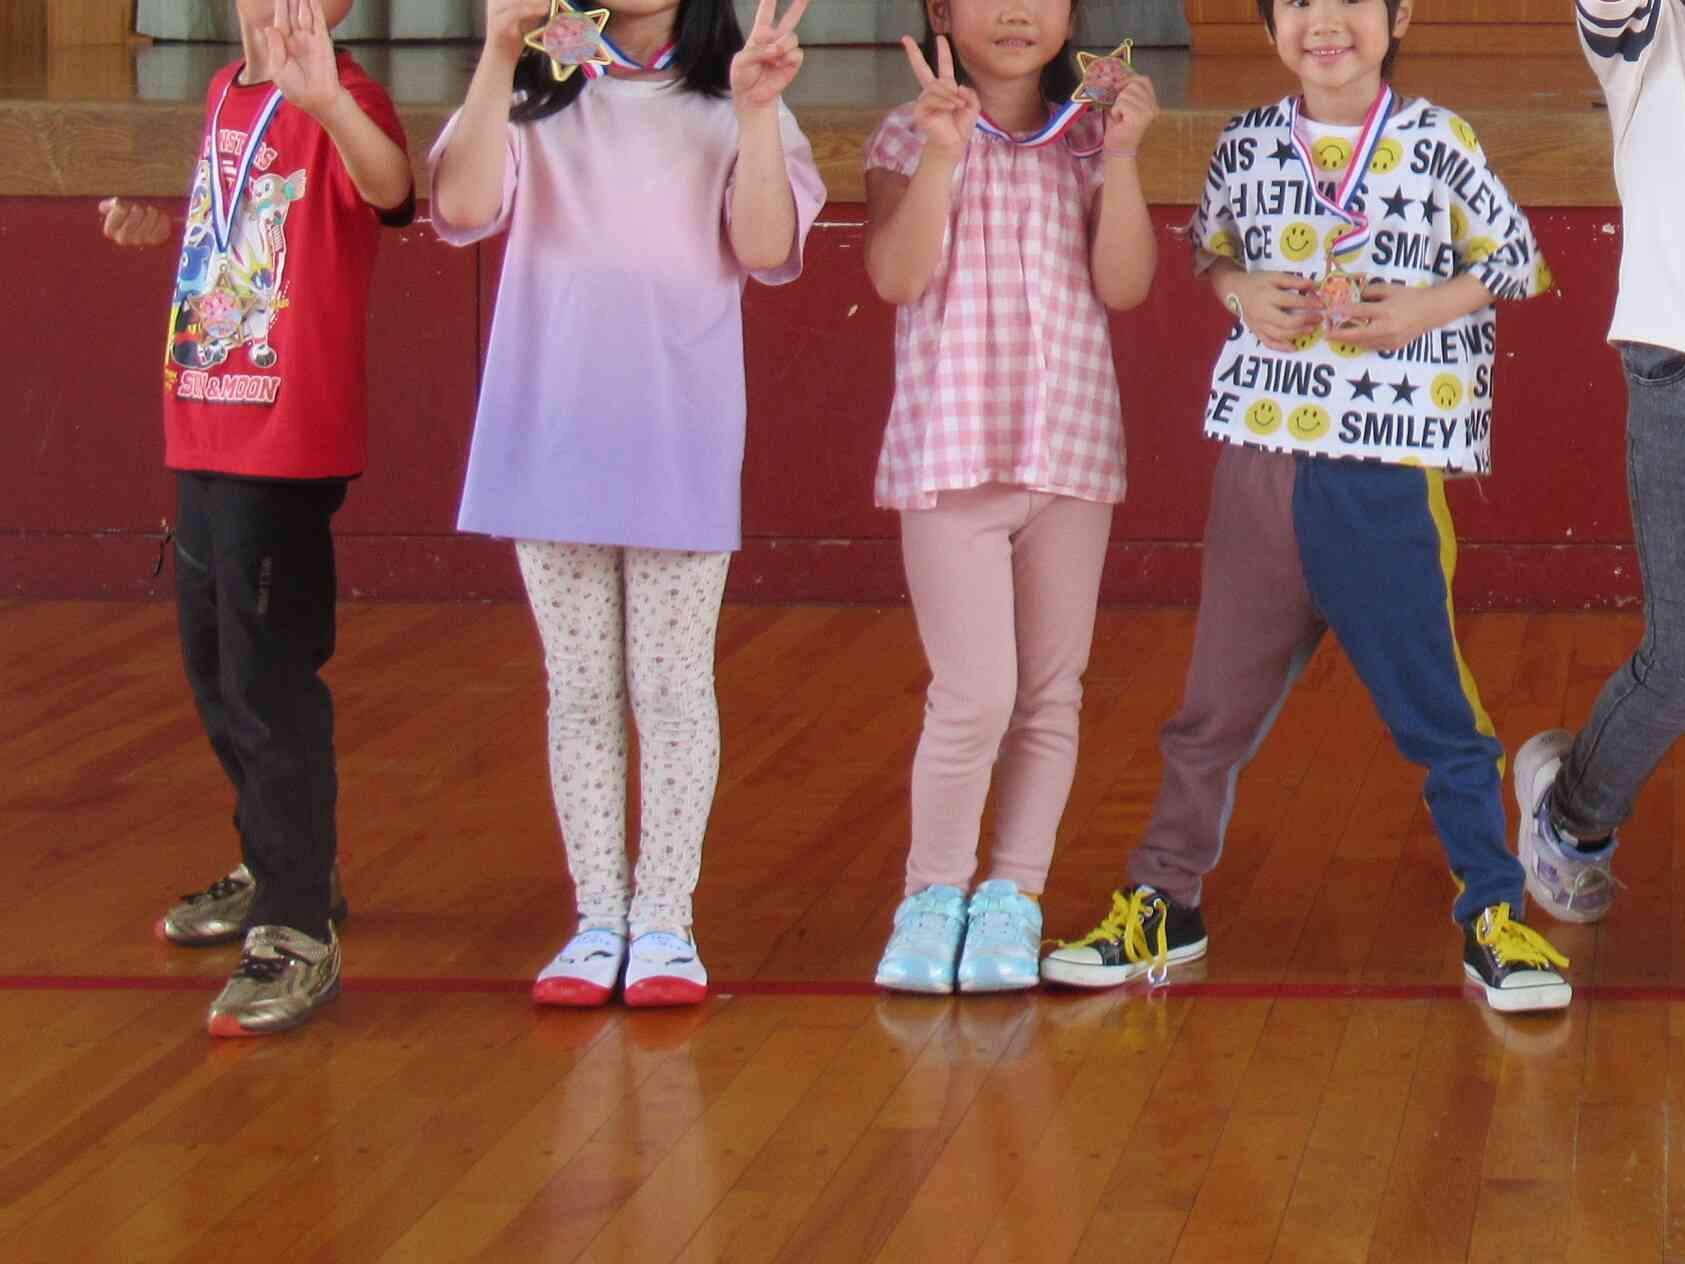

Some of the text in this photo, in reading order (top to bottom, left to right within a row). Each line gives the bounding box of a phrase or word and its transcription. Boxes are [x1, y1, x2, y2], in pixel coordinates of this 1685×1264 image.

[1411, 138, 1503, 225] SMILEY
[1208, 353, 1337, 399] SMILEY
[1338, 410, 1458, 450] SMILEY
